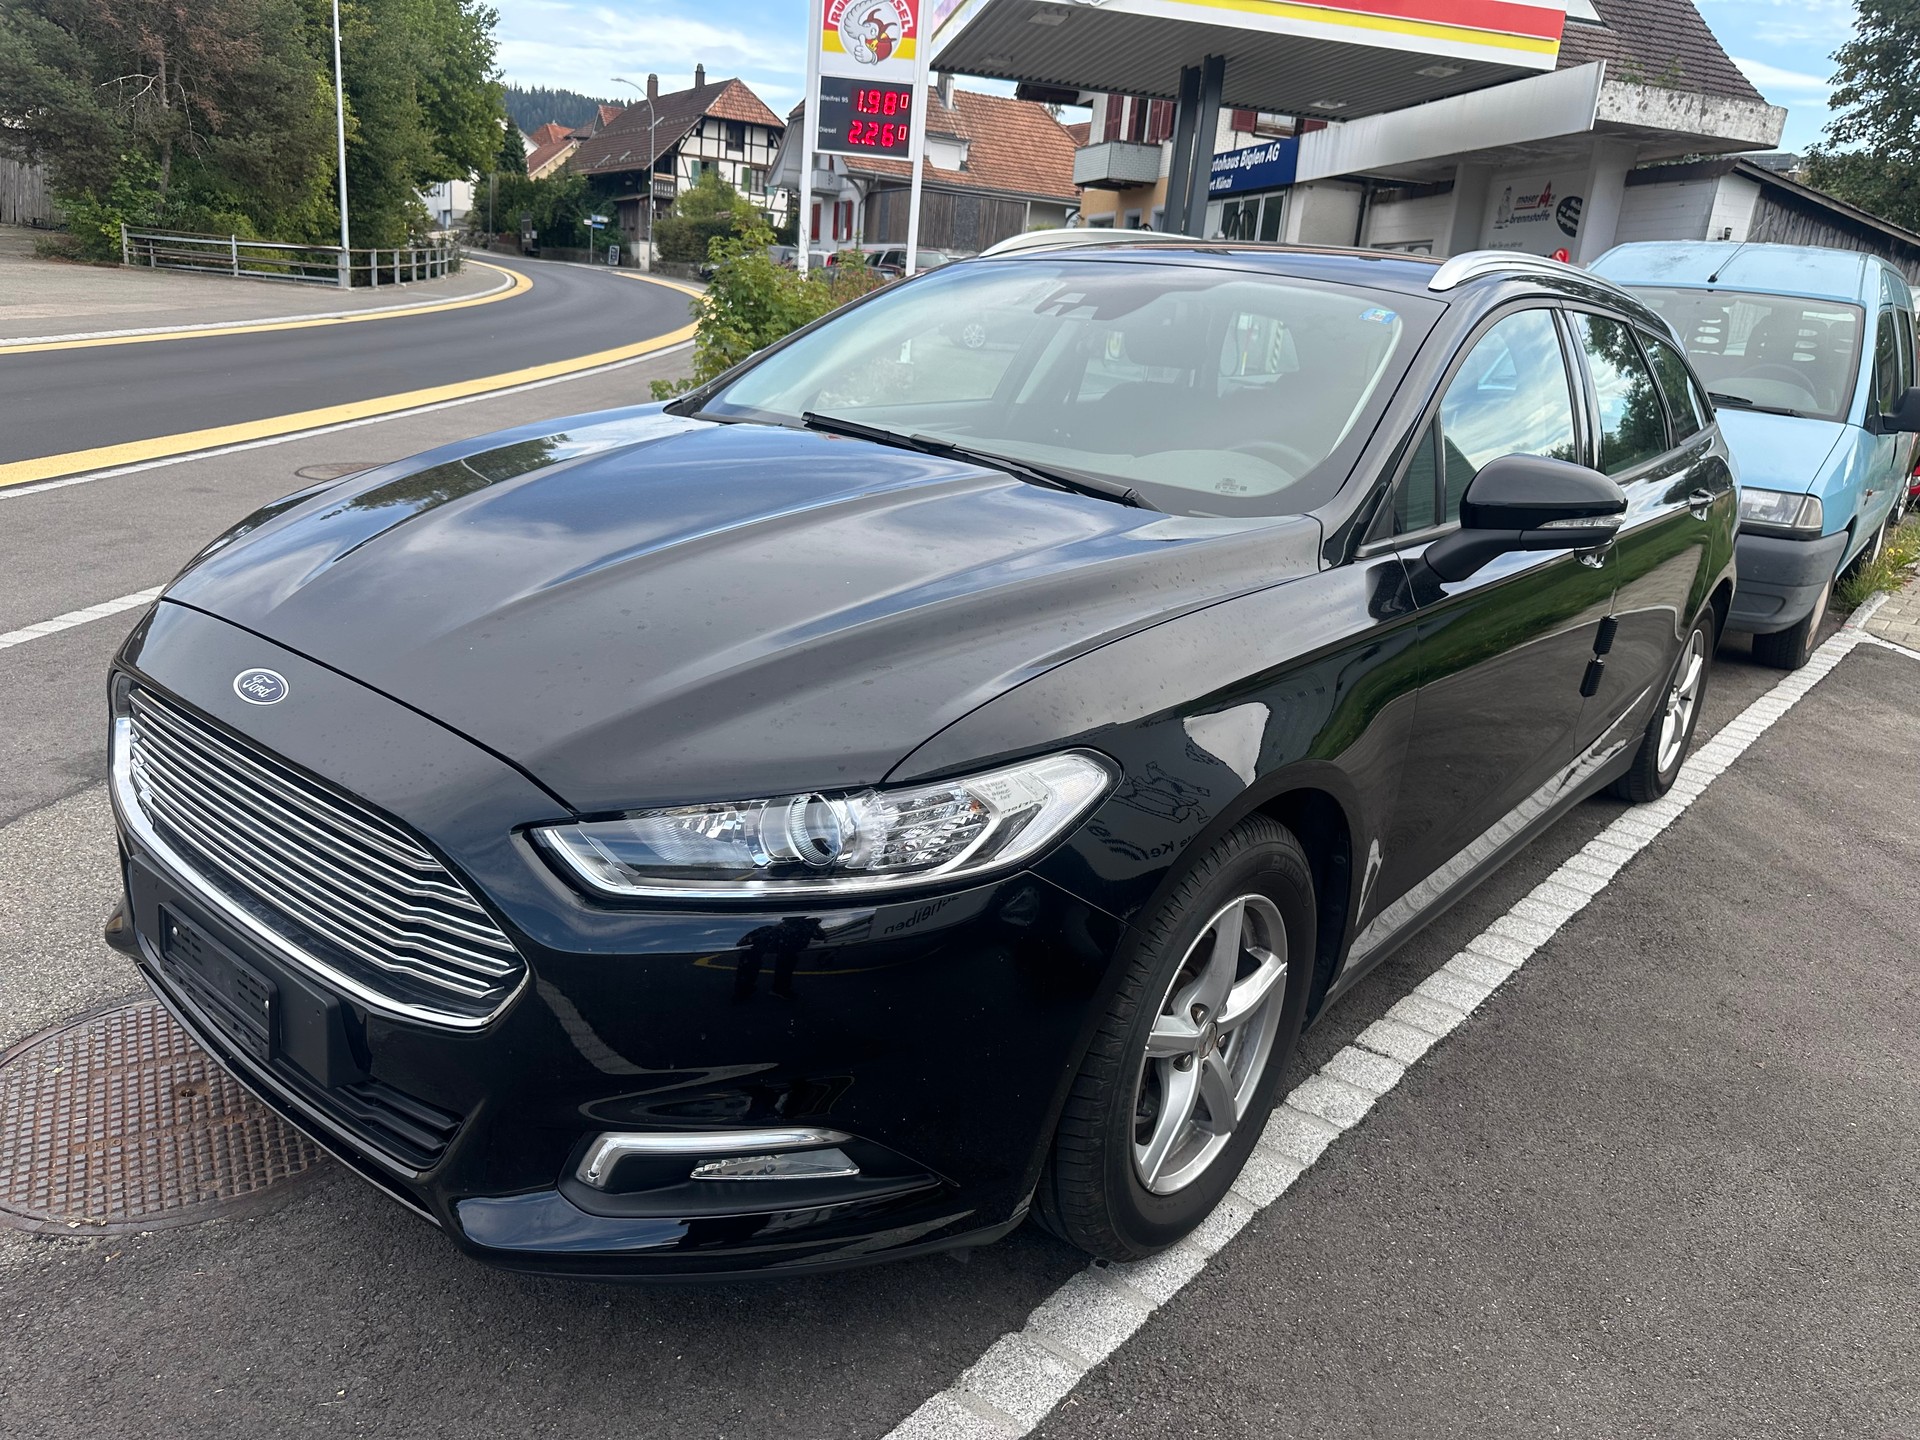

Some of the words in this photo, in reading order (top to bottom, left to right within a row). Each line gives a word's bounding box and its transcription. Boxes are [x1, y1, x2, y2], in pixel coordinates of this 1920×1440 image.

[819, 126, 837, 134] Diesel
[1240, 147, 1266, 170] Biglen
[1265, 143, 1280, 163] AG
[242, 674, 276, 697] Ford
